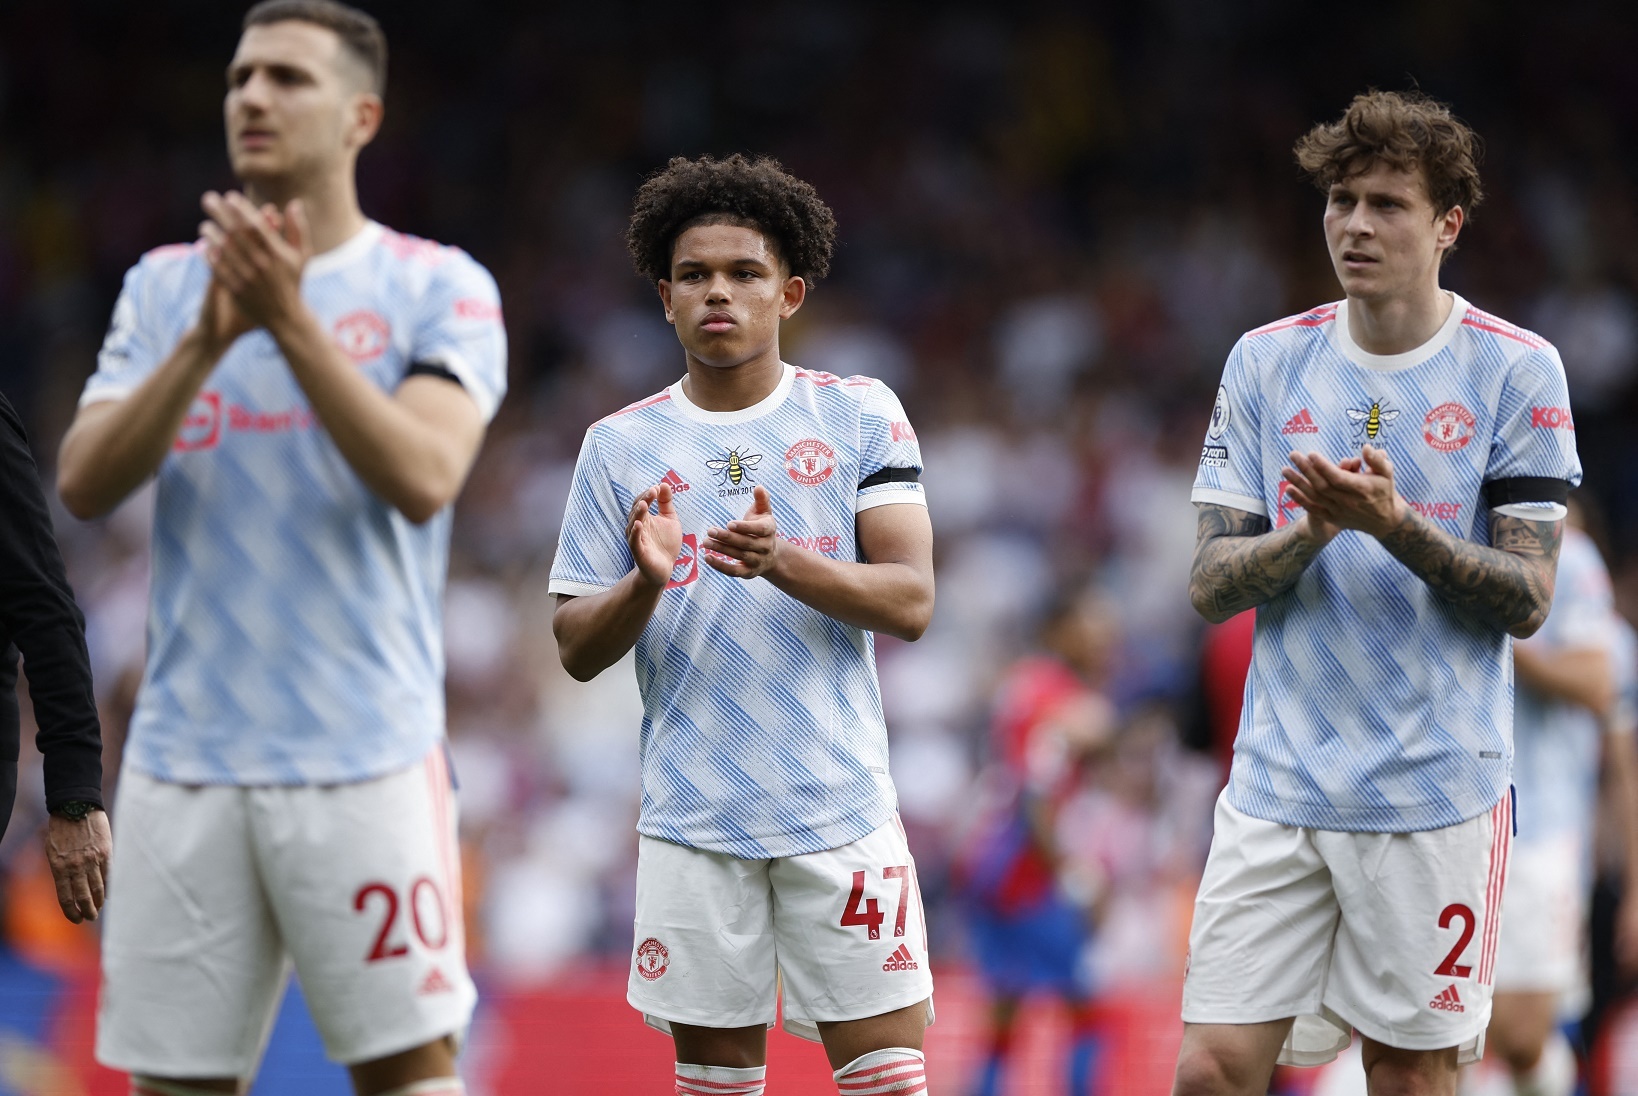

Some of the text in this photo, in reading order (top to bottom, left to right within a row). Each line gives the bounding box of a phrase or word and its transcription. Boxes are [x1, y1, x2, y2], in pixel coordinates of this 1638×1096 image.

[1282, 424, 1318, 434] adidas
[787, 441, 831, 458] MANCHESTER
[796, 474, 826, 484] UNITED
[718, 489, 727, 498] 22
[728, 487, 740, 497] MAY
[840, 865, 909, 940] 47
[353, 878, 448, 963] 20
[1433, 903, 1476, 978] 2
[882, 960, 919, 972] adidas
[1429, 1000, 1465, 1012] adidas
